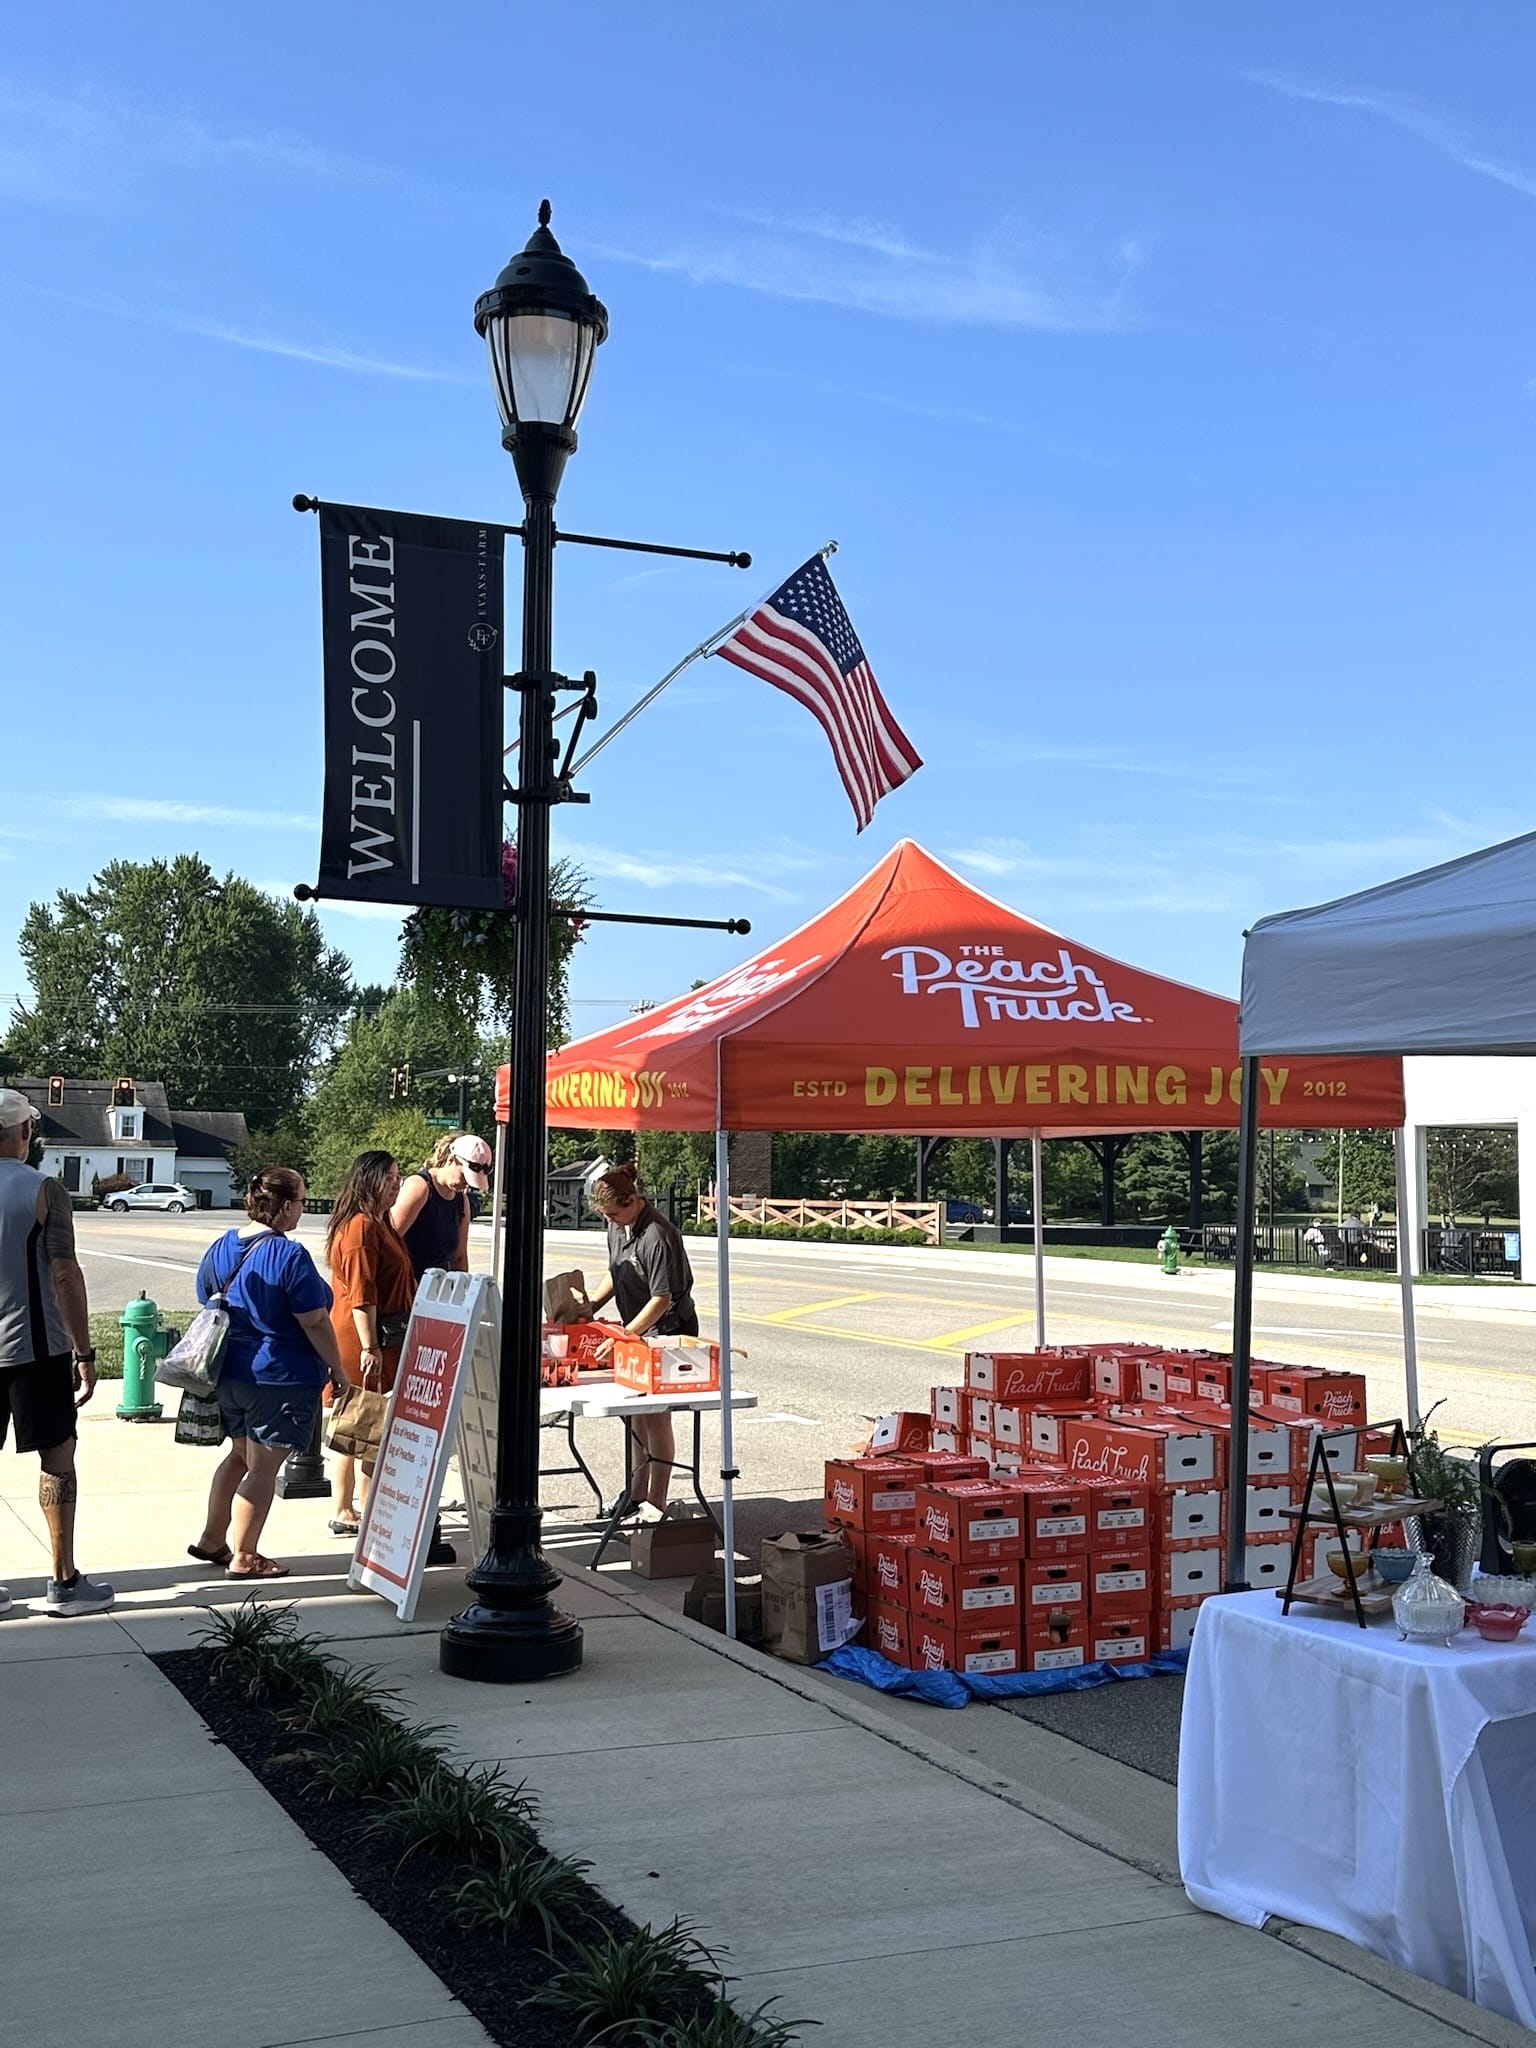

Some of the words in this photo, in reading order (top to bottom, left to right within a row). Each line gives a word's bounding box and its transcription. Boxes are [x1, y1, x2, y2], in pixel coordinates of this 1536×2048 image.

[478, 529, 487, 566] FARM
[478, 574, 487, 616] EVANS
[347, 534, 396, 880] WELCOME
[881, 945, 1104, 994] Peach
[959, 946, 1004, 956] THE
[927, 981, 1142, 1028] Truck
[631, 1071, 667, 1109] JOY
[668, 1082, 689, 1098] 2012
[793, 1080, 847, 1098] ESTD
[864, 1064, 1188, 1107] DELIVERING
[1303, 1080, 1347, 1097] 2012
[414, 1345, 448, 1377] TODAY'S
[403, 1374, 443, 1409] SPECIALS:
[1004, 1369, 1043, 1397] Peach
[1046, 1367, 1081, 1394] Truck
[1322, 1389, 1353, 1408] Peach
[1326, 1402, 1353, 1419] Truck
[1071, 1438, 1110, 1473] Peach
[1110, 1446, 1150, 1482] Truck
[926, 1506, 949, 1525] Peach
